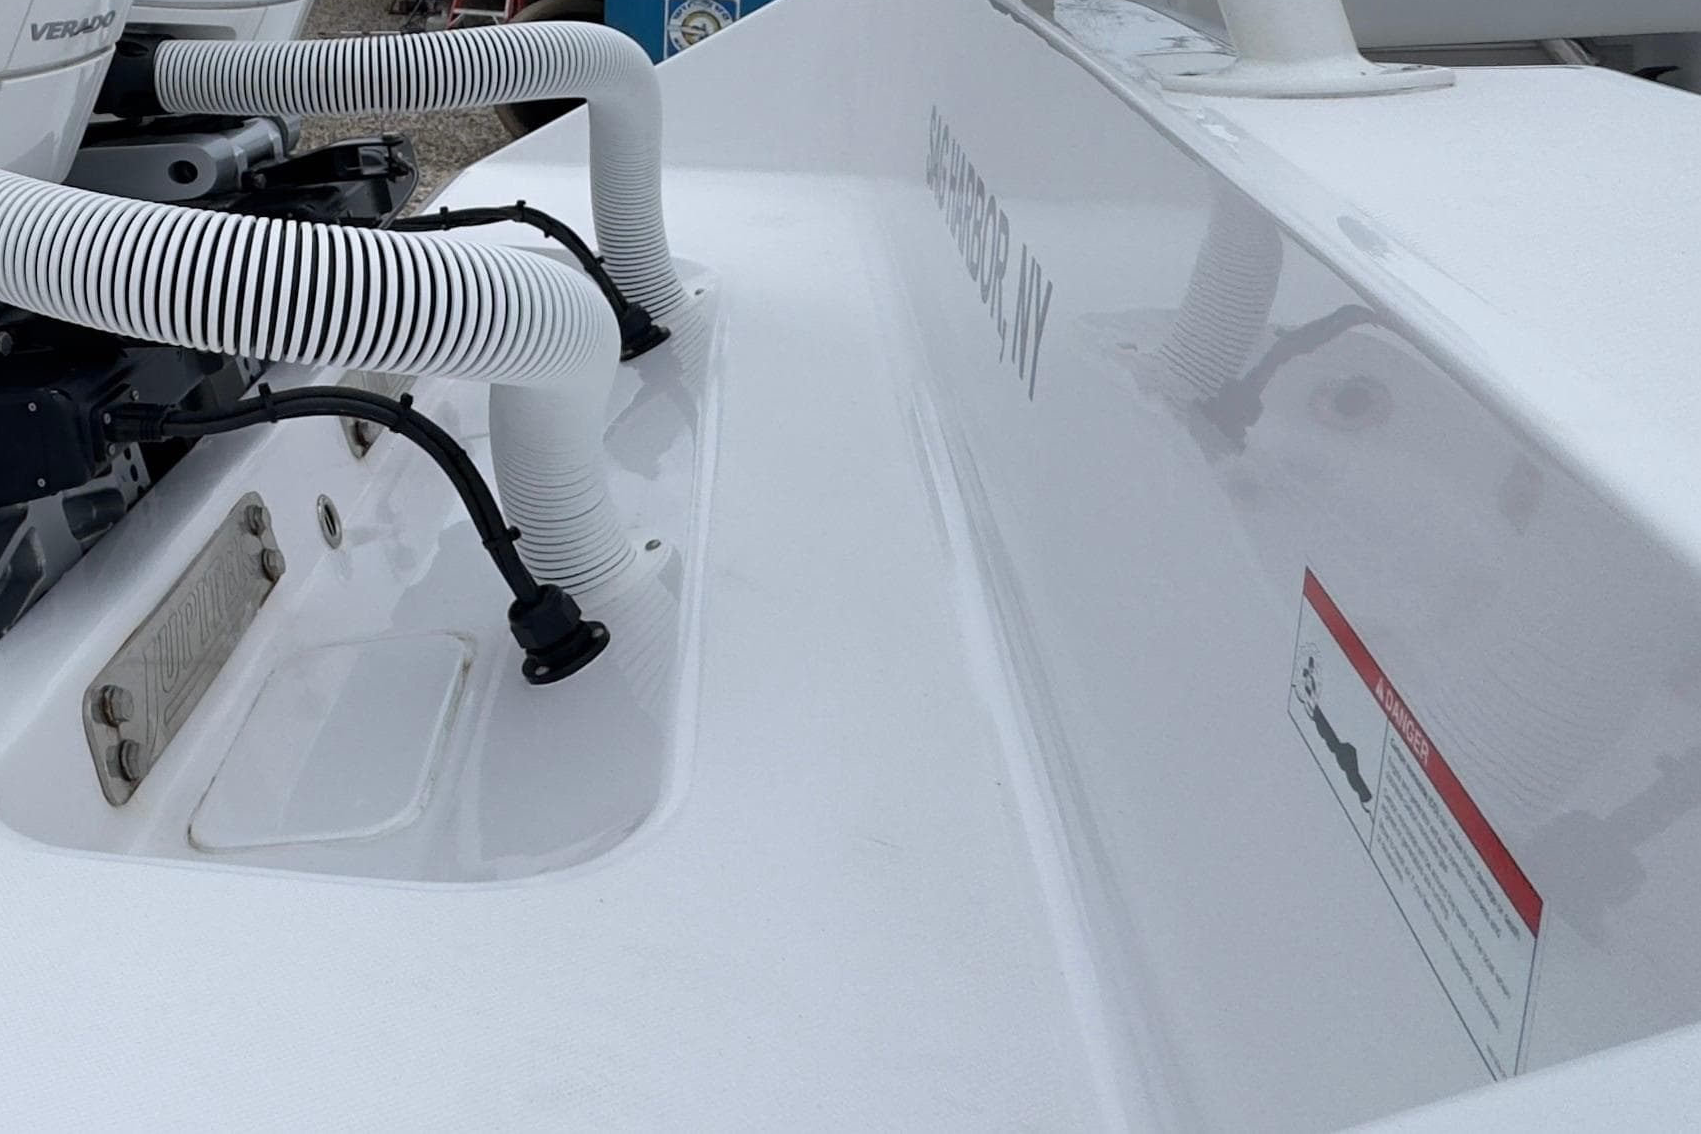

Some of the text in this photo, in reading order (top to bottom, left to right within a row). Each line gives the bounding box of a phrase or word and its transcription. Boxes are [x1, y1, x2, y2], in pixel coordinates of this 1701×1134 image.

[30, 9, 116, 42] VERADO
[945, 136, 1010, 364] HARBOR,
[1011, 242, 1053, 402] NY
[1385, 689, 1430, 767] DANGER
